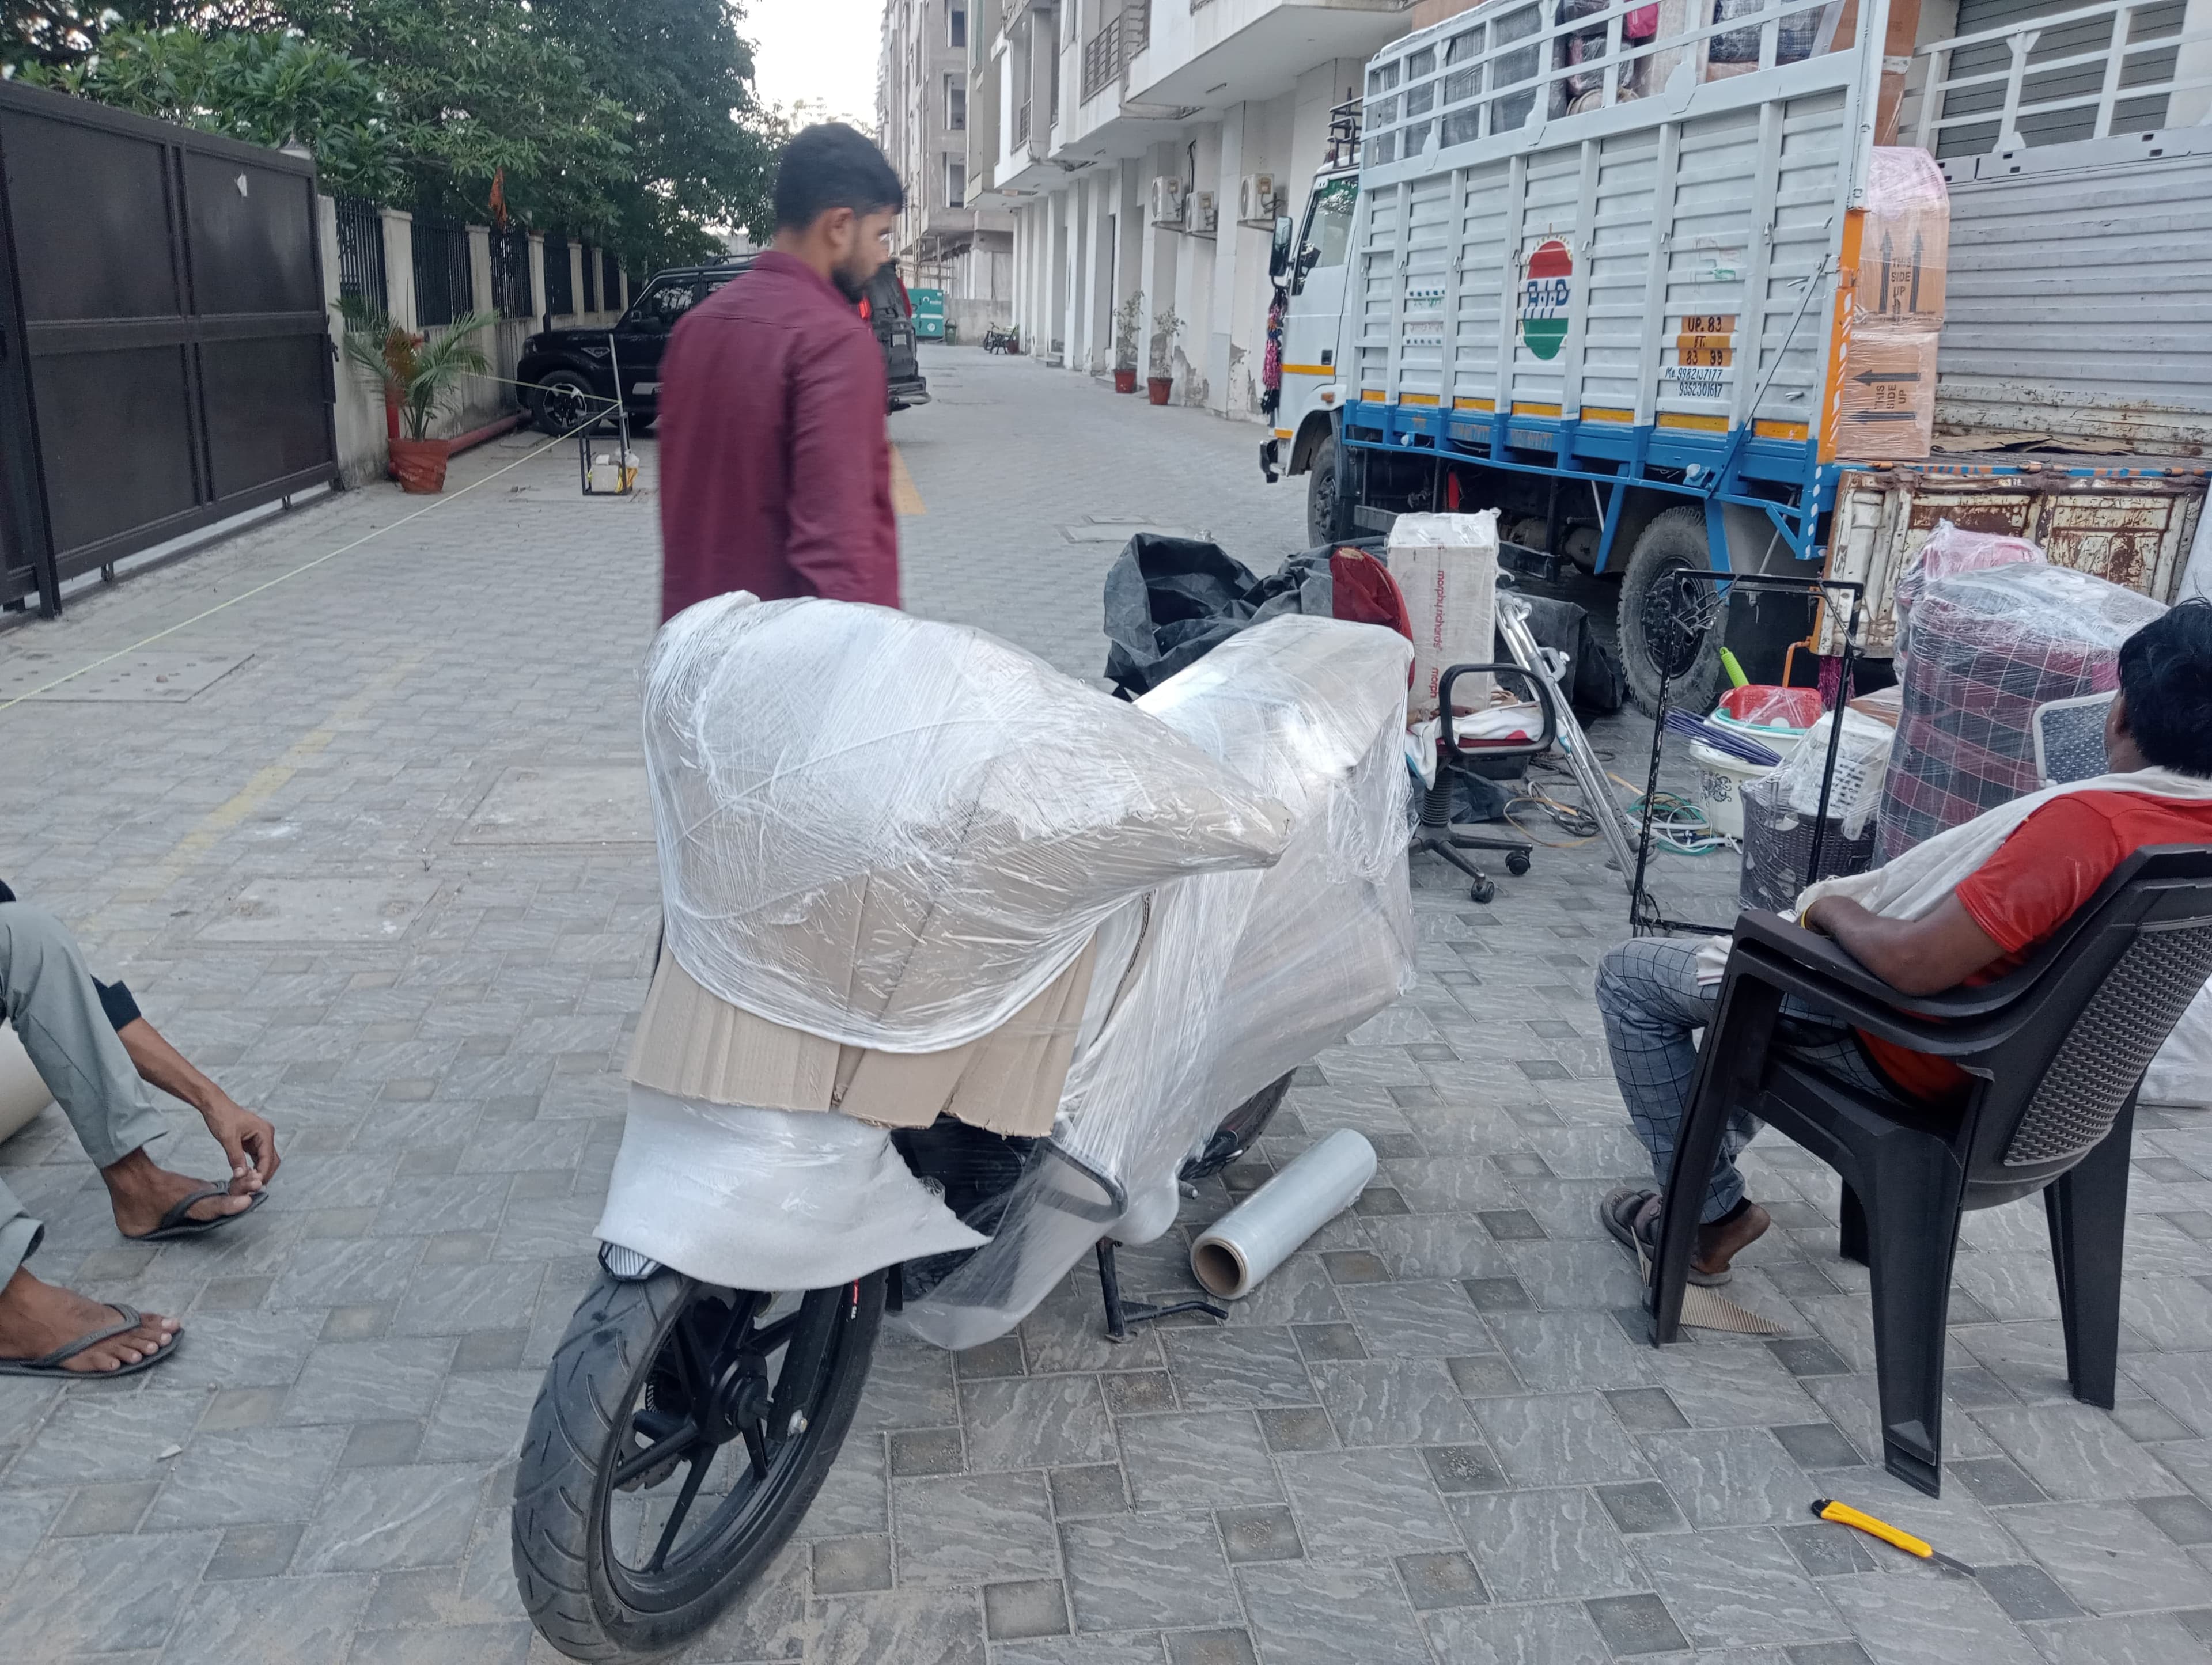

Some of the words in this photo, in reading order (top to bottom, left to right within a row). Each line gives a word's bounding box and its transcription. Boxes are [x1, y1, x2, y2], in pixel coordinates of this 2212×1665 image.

[1891, 271, 1911, 282] SIDE
[1893, 286, 1906, 298] UP
[1708, 316, 1722, 332] 83
[1679, 382, 1723, 397] 9352301617
[1886, 384, 1896, 409] SIDE
[1898, 390, 1907, 404] UP
[1434, 571, 1446, 607] morphy
